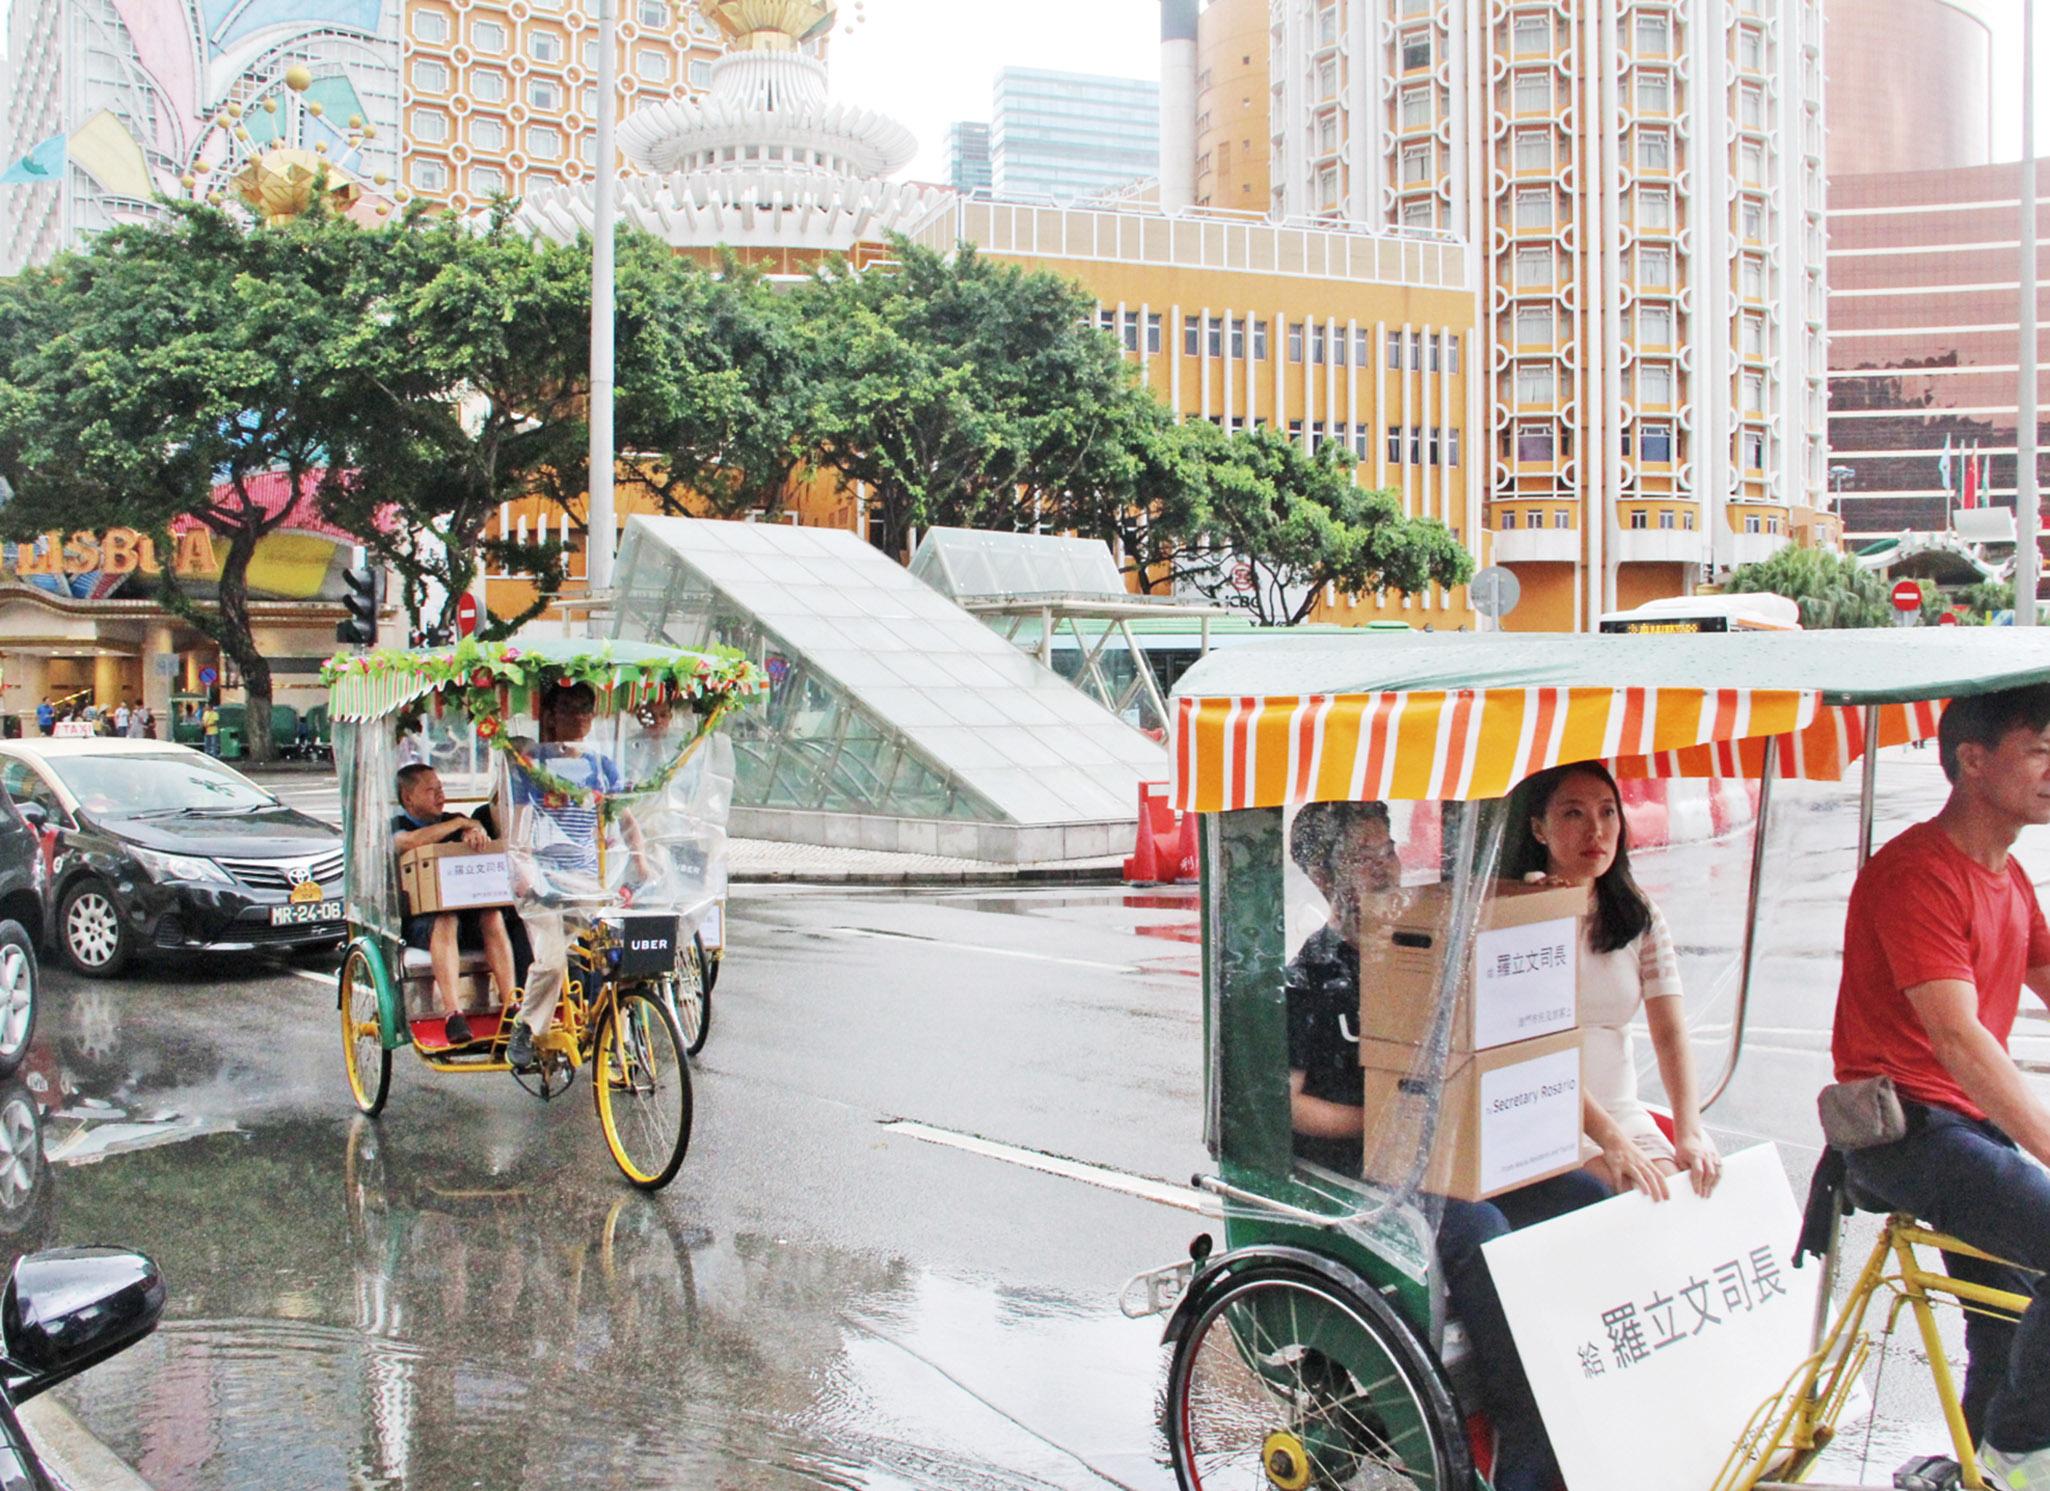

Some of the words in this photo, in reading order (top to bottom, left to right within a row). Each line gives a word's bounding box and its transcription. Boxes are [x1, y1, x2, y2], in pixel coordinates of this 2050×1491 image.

[63, 723, 92, 734] TAXI
[631, 939, 668, 951] UBER
[1493, 1090, 1538, 1114] Secretary
[1541, 1079, 1577, 1099] Rosario
